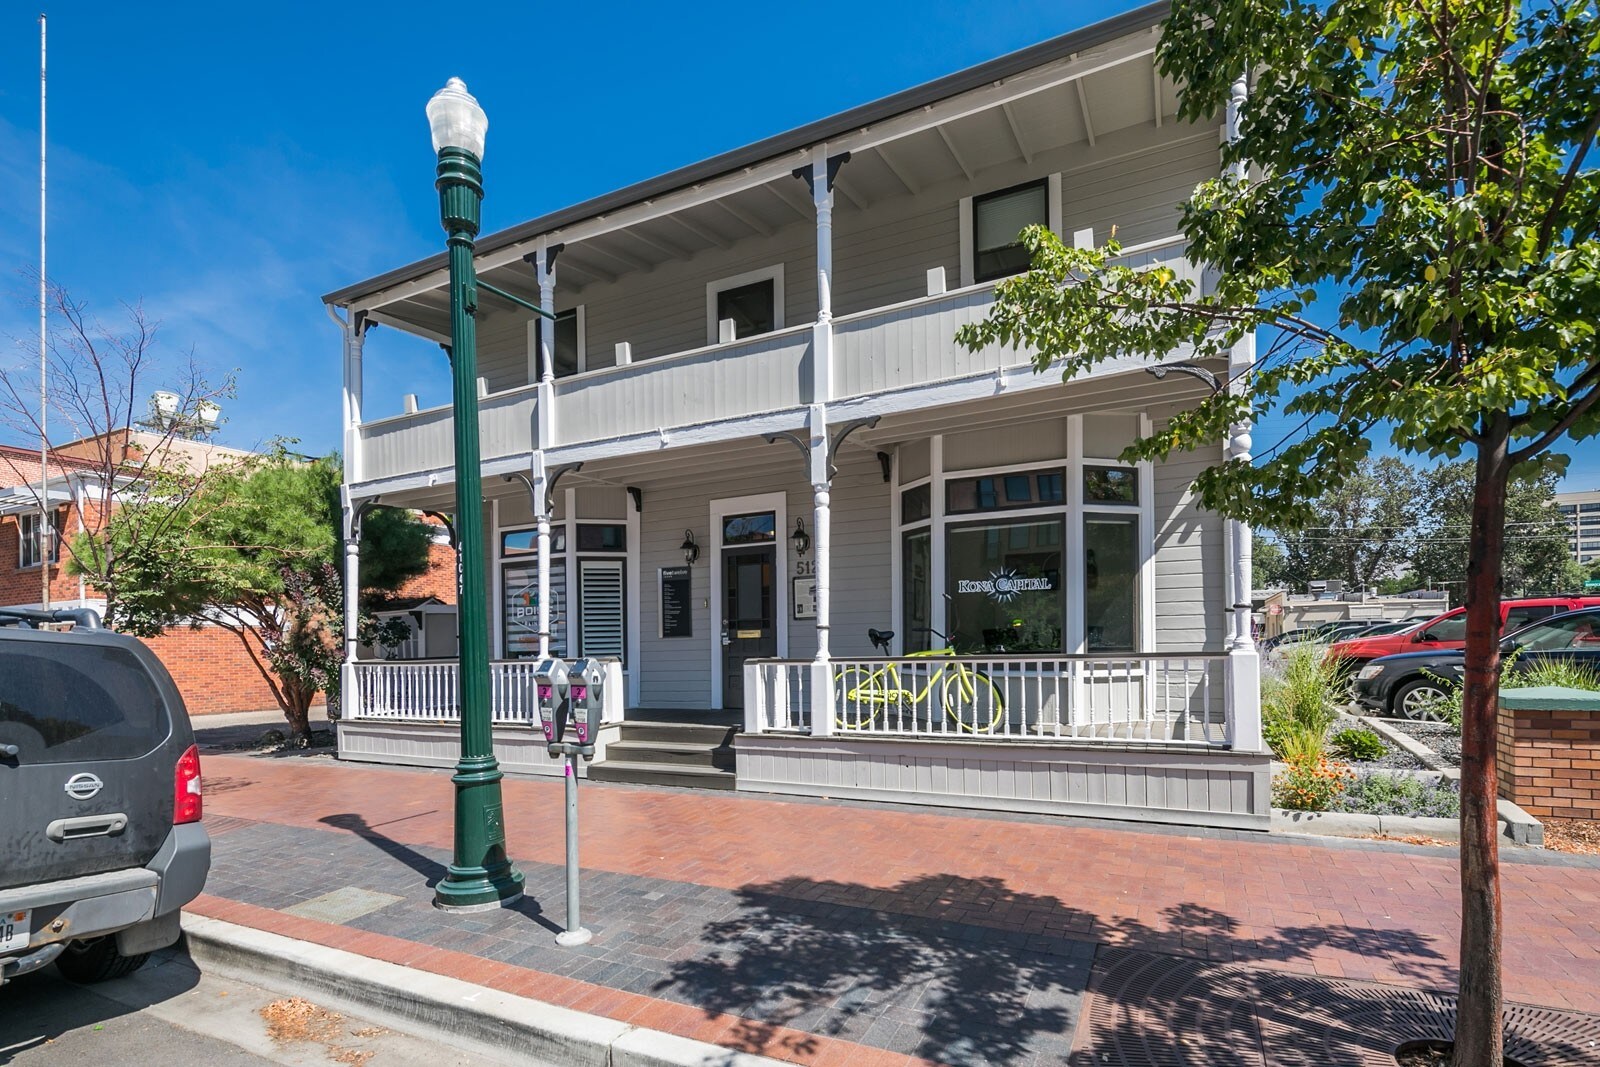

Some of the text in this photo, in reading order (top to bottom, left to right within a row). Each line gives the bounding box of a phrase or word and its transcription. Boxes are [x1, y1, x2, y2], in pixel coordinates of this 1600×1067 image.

[959, 578, 1052, 593] KONA CAPITAL
[542, 687, 547, 695] 2
[576, 687, 581, 696] 2
